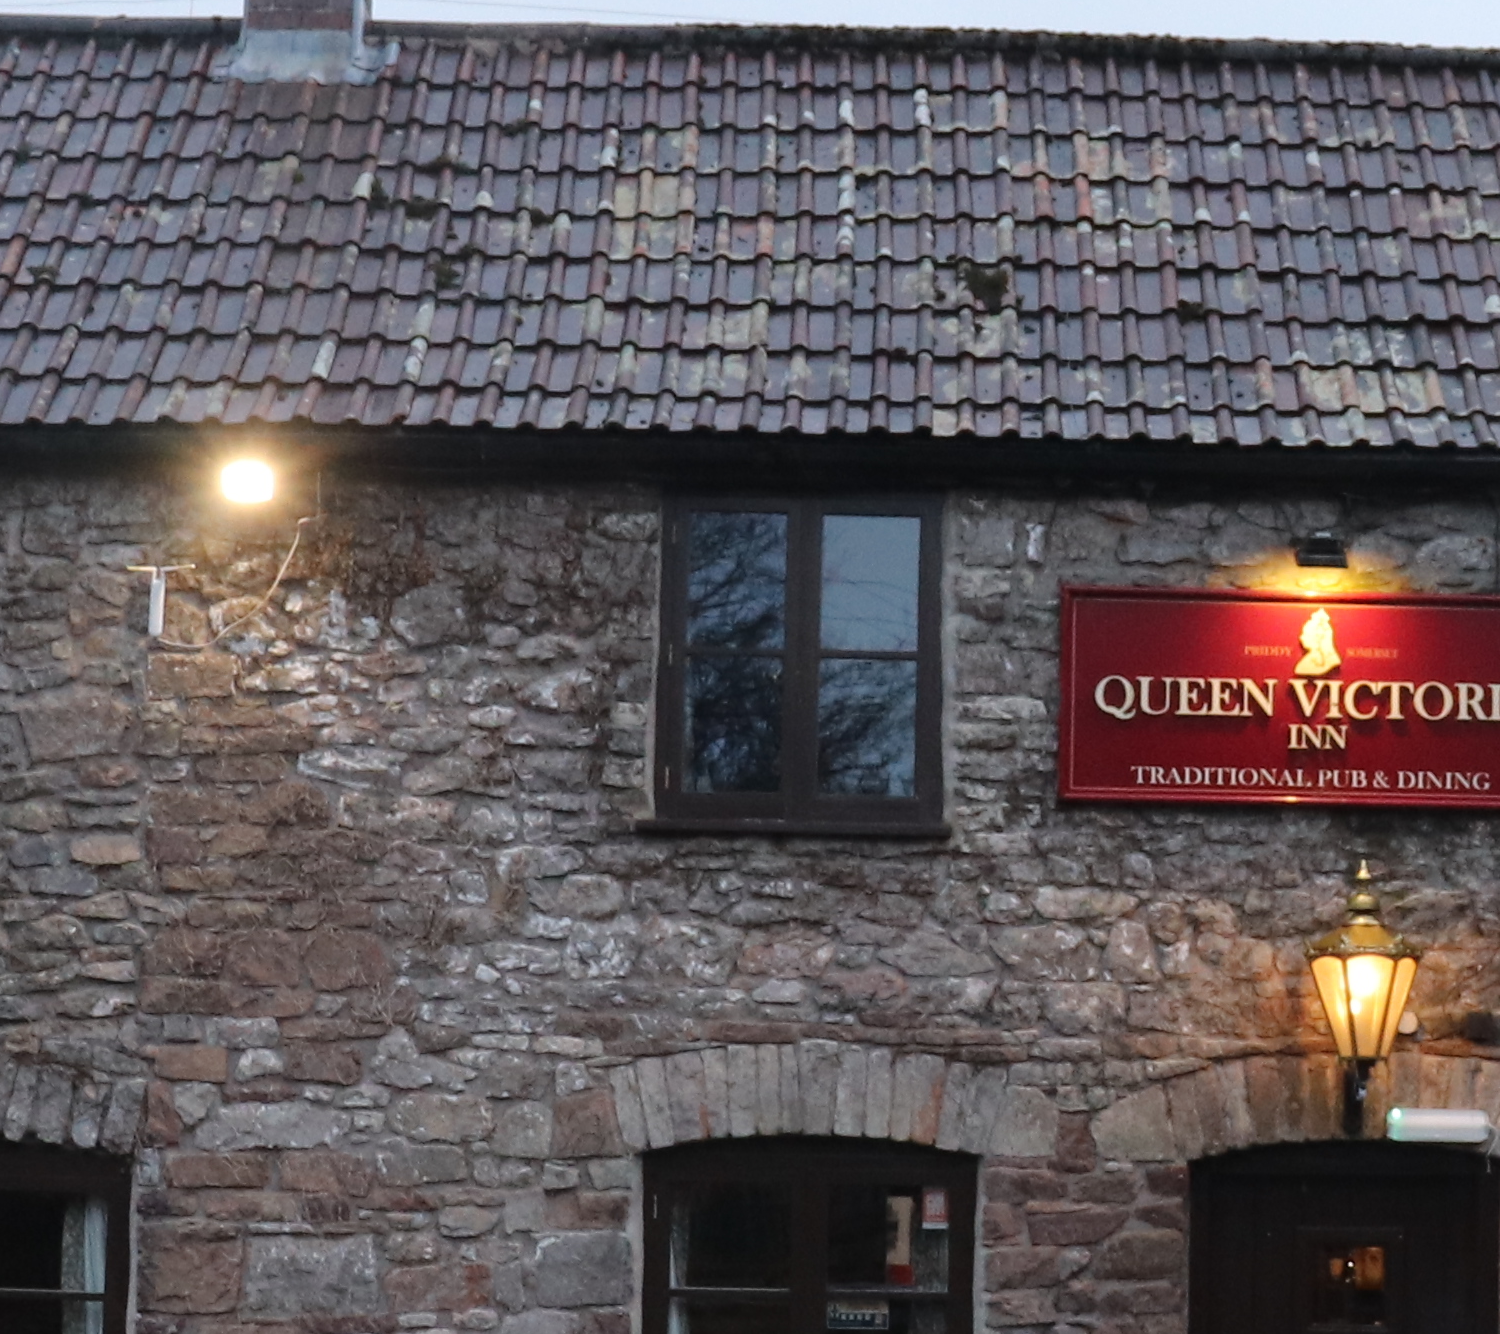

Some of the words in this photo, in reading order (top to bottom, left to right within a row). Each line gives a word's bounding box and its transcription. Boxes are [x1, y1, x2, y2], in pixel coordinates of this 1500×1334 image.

[1094, 675, 1279, 720] QUEEN
[1287, 724, 1349, 750] INN
[1130, 766, 1312, 788] TRADITIONAL
[1317, 769, 1368, 789] PUB
[1372, 770, 1391, 789] &
[1396, 771, 1491, 791] DINING
